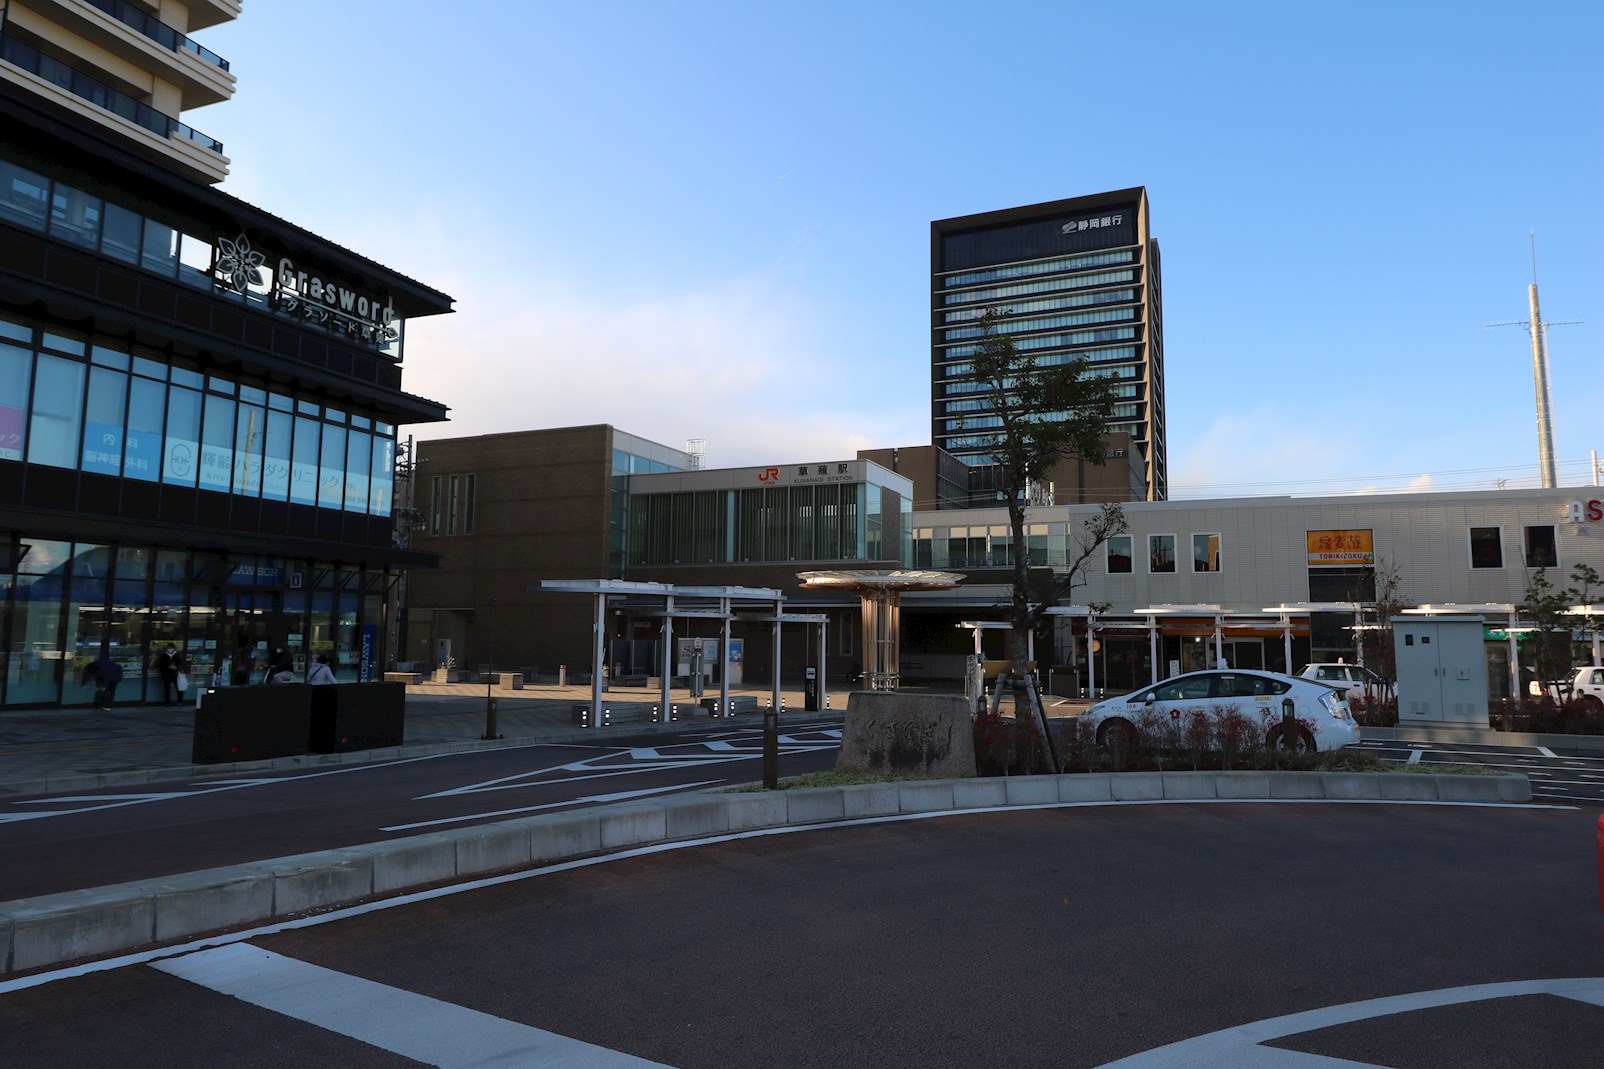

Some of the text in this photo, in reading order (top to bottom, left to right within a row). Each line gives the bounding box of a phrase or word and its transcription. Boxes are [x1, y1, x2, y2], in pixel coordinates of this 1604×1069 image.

[1078, 214, 1122, 231] 静岡銀行
[278, 257, 394, 325] Grasword
[758, 467, 779, 481] JR
[799, 463, 848, 477] 草薙駅
[1319, 552, 1363, 560] TORIKIZOKU
[359, 633, 371, 683] LAWSON
